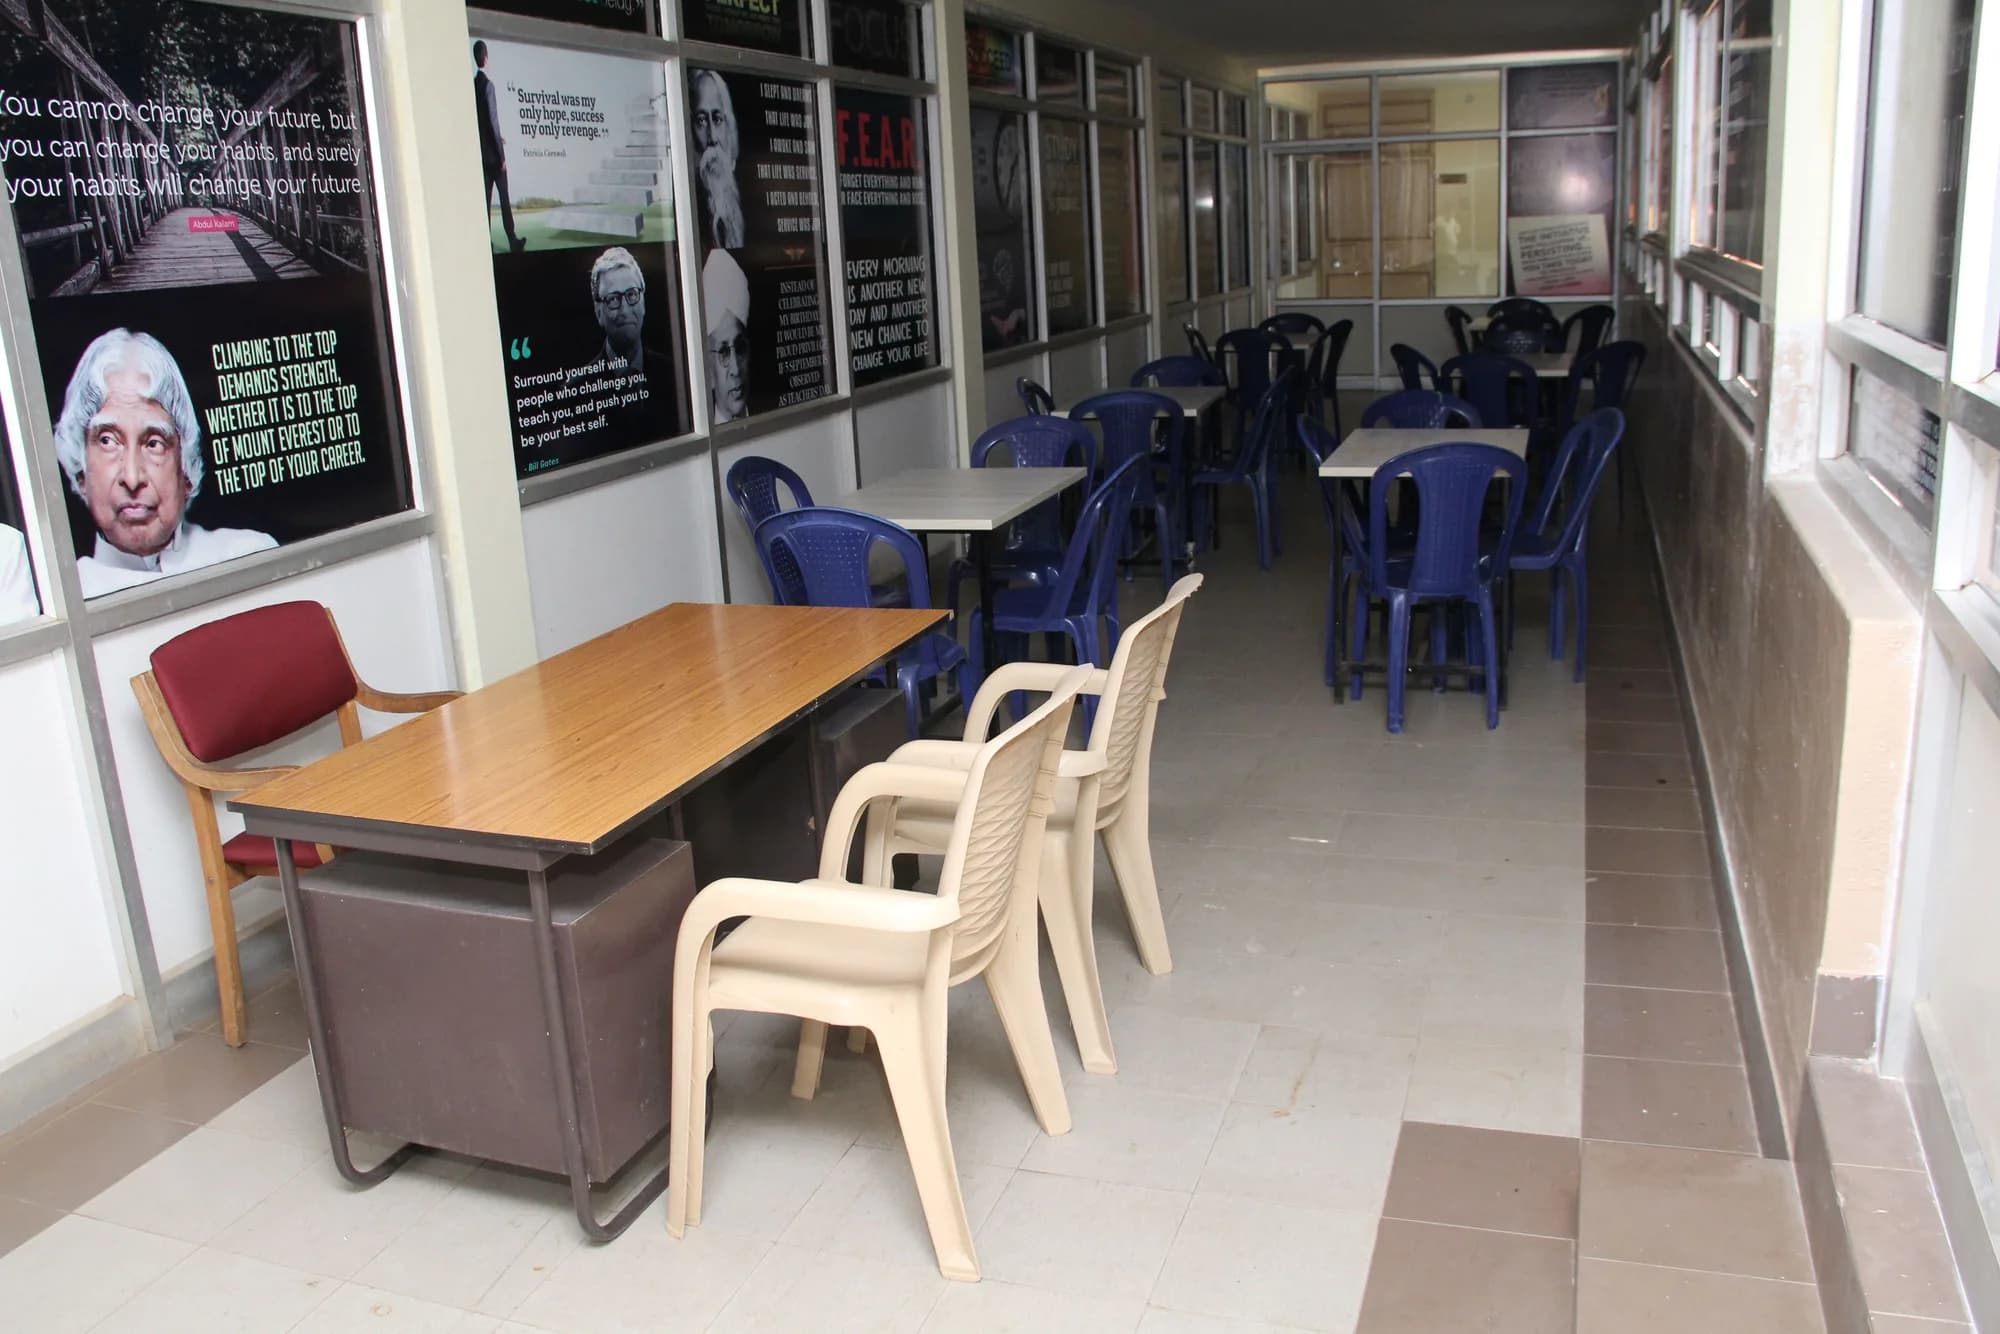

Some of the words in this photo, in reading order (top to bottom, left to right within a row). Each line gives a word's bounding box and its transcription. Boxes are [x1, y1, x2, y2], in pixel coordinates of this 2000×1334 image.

[48, 99, 131, 121] cannot
[137, 99, 214, 129] change
[219, 108, 263, 131] your
[268, 105, 325, 131] future,
[328, 108, 358, 130] but
[519, 105, 542, 123] only
[543, 106, 570, 124] hope,
[570, 111, 605, 123] success
[561, 94, 580, 107] was
[581, 96, 596, 111] my
[521, 123, 538, 139] my
[539, 122, 560, 140] only
[0, 139, 44, 162] you
[50, 139, 91, 158] can
[96, 137, 170, 164] change
[175, 143, 217, 165] your
[221, 139, 279, 163] habits,
[283, 142, 313, 162] and
[317, 144, 361, 166] surely
[6, 178, 63, 203] your
[146, 173, 184, 195] will
[190, 173, 261, 200] change
[265, 178, 306, 199] your
[311, 172, 365, 195] future.
[193, 219, 212, 228] Abdul
[213, 219, 235, 228] Kalam
[847, 259, 879, 280] EVERY
[883, 255, 926, 276] MORNING
[848, 285, 856, 304] IS
[860, 280, 904, 302] ANOTHER
[907, 277, 927, 296] NEW
[848, 307, 866, 326] DAY
[870, 304, 888, 322] AND
[892, 298, 928, 319] ANOTHER
[212, 338, 273, 370] CLIMBING
[273, 336, 290, 362] TO
[291, 333, 314, 359] THE
[314, 330, 337, 356] TOP
[851, 328, 873, 350] NEW
[878, 322, 912, 345] CHANCE
[916, 319, 929, 337] TO
[514, 368, 563, 389] Surround
[565, 359, 605, 383] yourself
[607, 356, 628, 371] with
[852, 351, 884, 373] CHANGE
[886, 345, 911, 364] YOUR
[914, 341, 930, 358] LIFE
[218, 368, 279, 401] DEMANDS
[280, 359, 341, 390] STRENGTH,
[516, 390, 554, 413] people
[556, 386, 578, 400] who
[580, 376, 627, 394] challenge
[628, 372, 648, 388] you,
[205, 400, 267, 435] WHETHER
[268, 398, 279, 424] IT
[282, 395, 295, 421] IS
[295, 393, 312, 418] TO
[313, 388, 335, 415] THE
[336, 384, 357, 410] TOP
[519, 410, 553, 428] teach
[552, 409, 574, 425] you,
[575, 400, 594, 415] and
[596, 393, 620, 413] push
[621, 392, 639, 407] you
[639, 389, 650, 400] to
[212, 438, 229, 465] OF
[231, 428, 276, 462] MOUNT
[278, 419, 326, 451] EVEREST
[327, 415, 345, 441] OR
[345, 412, 360, 437] TO
[520, 434, 535, 448] be
[537, 429, 561, 448] your
[563, 422, 586, 437] best
[588, 415, 609, 430] self.
[215, 467, 242, 496] THE
[241, 461, 266, 490] TOP
[269, 457, 285, 484] OF
[286, 450, 320, 480] YOUR
[320, 440, 366, 472] CAREER.
[528, 461, 538, 472] Bill
[540, 457, 560, 469] Gates
